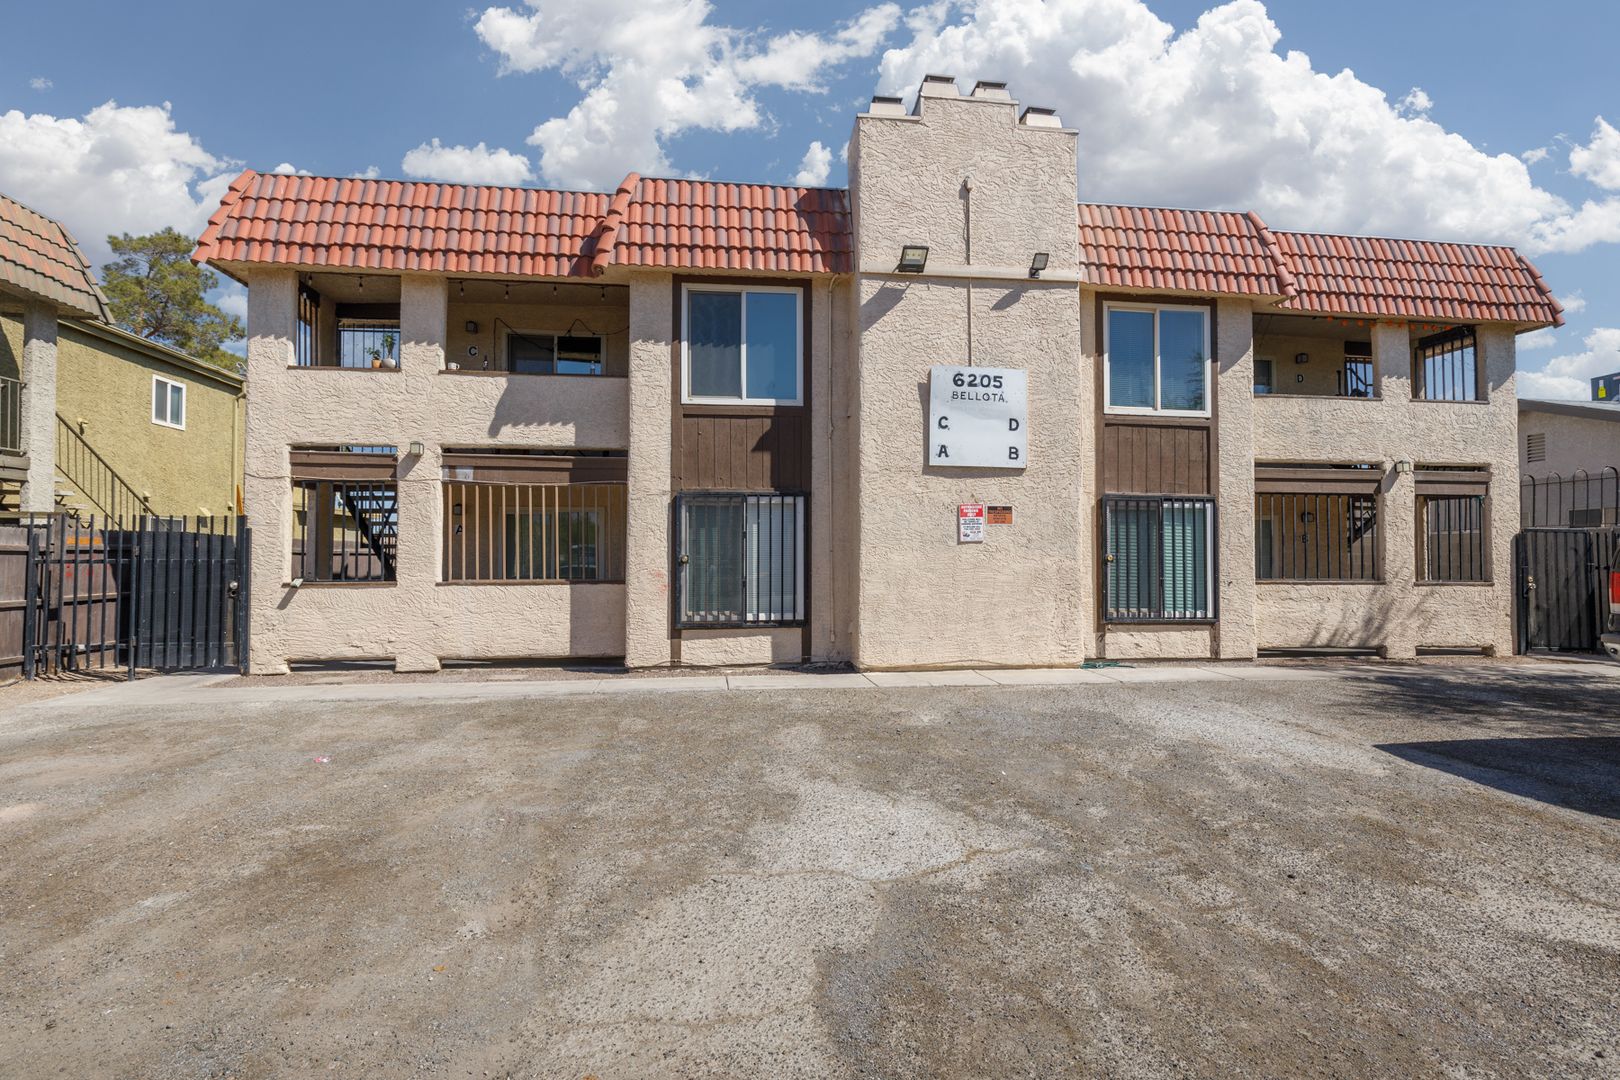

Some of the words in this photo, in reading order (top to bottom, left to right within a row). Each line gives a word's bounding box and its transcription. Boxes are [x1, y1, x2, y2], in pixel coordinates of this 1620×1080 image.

[468, 346, 477, 356] C
[952, 372, 1003, 388] 6205
[1297, 374, 1304, 382] D
[952, 391, 1005, 402] BELLOTA
[938, 416, 948, 430] C
[1008, 418, 1020, 431] D
[938, 444, 949, 458] A
[1008, 446, 1019, 460] B
